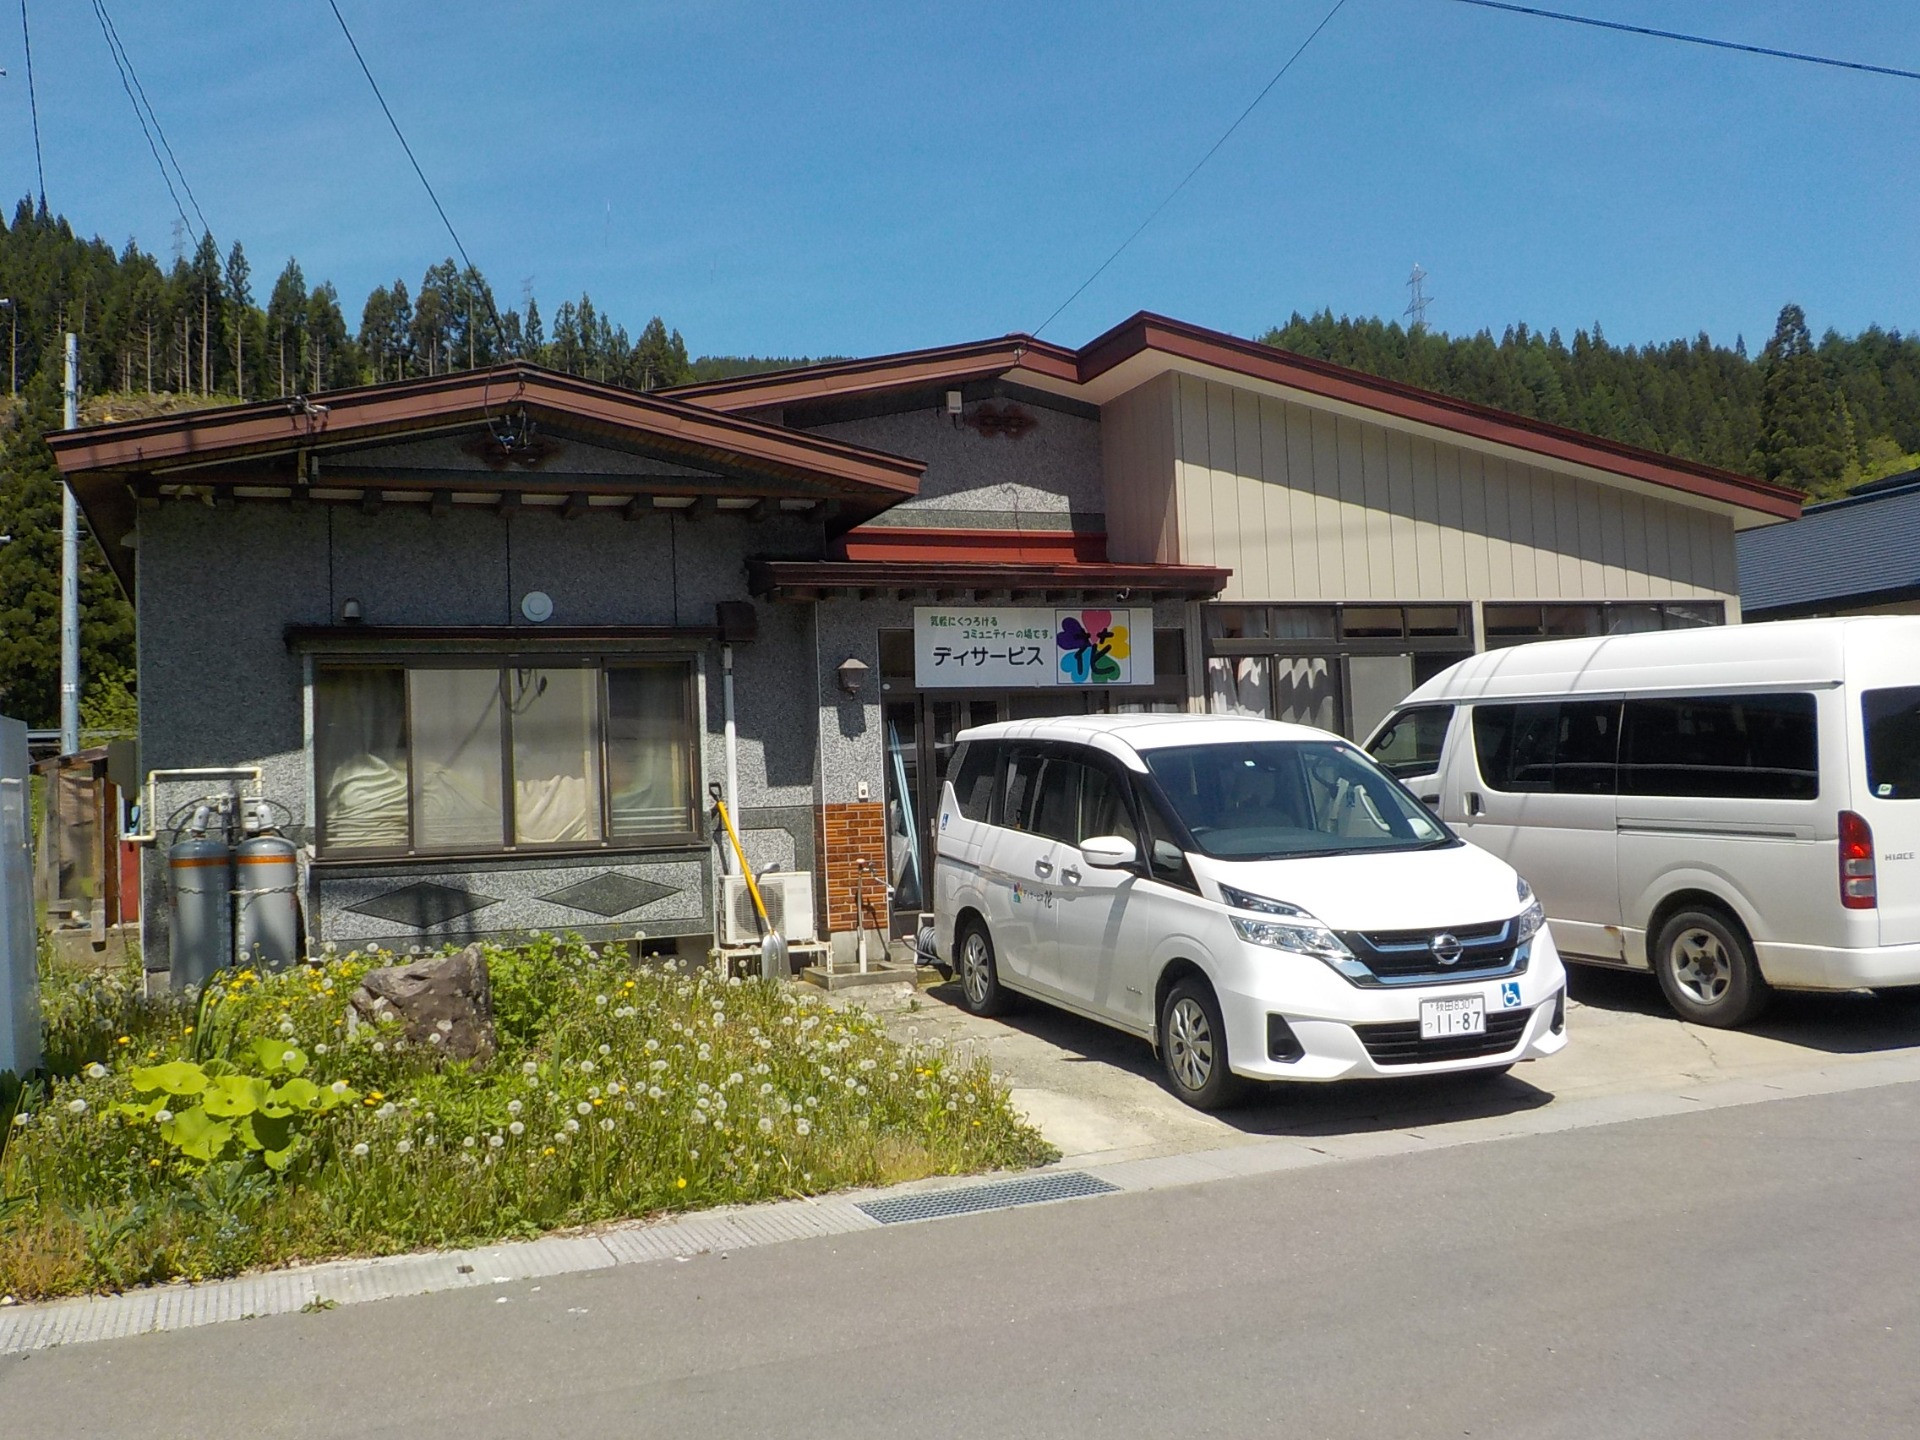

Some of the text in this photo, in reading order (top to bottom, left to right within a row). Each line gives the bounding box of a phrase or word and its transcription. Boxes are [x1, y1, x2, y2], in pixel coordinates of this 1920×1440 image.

[1074, 627, 1115, 676] 花
[1884, 852, 1915, 861] HIACE
[1437, 1011, 1481, 1033] 11-87
